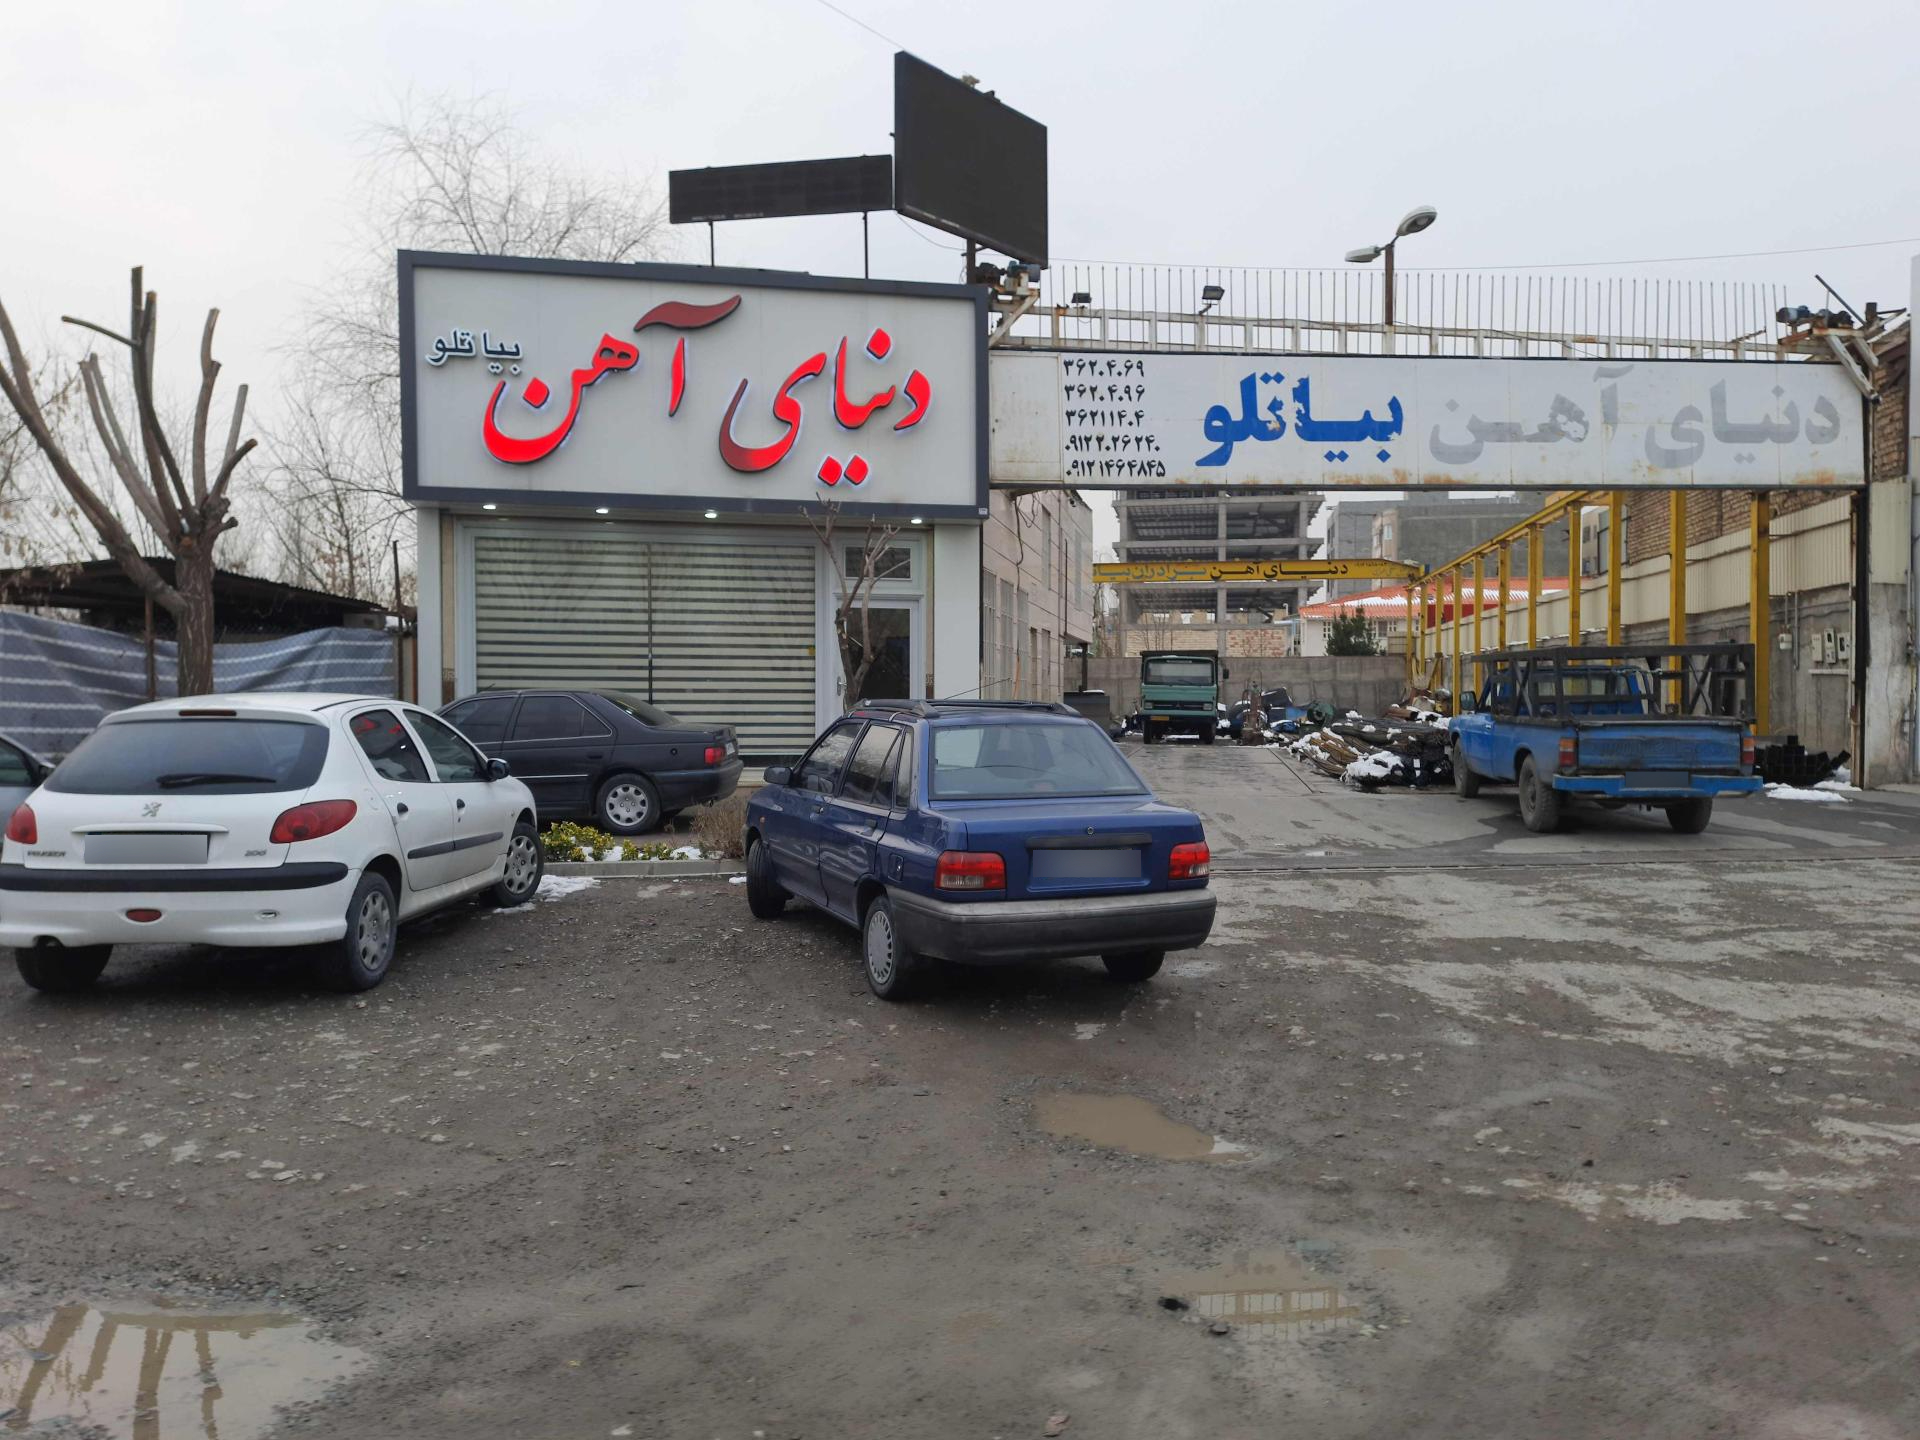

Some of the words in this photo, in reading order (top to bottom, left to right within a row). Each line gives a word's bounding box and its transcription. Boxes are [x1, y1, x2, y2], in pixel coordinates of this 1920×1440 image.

[1063, 358, 1144, 377] ۳۶۲۰۴۰۶۹
[481, 295, 742, 464] آهن
[1064, 383, 1145, 402] ۳۶۲۰۴۰۹۶
[719, 327, 932, 486] دنیای
[1429, 364, 1635, 465] آهن
[1065, 408, 1144, 427] ۳۶۲۱۱۴۰۴
[1644, 378, 1842, 471] دنیای
[1209, 560, 1261, 580] آهن
[1263, 561, 1349, 580] دنیای
